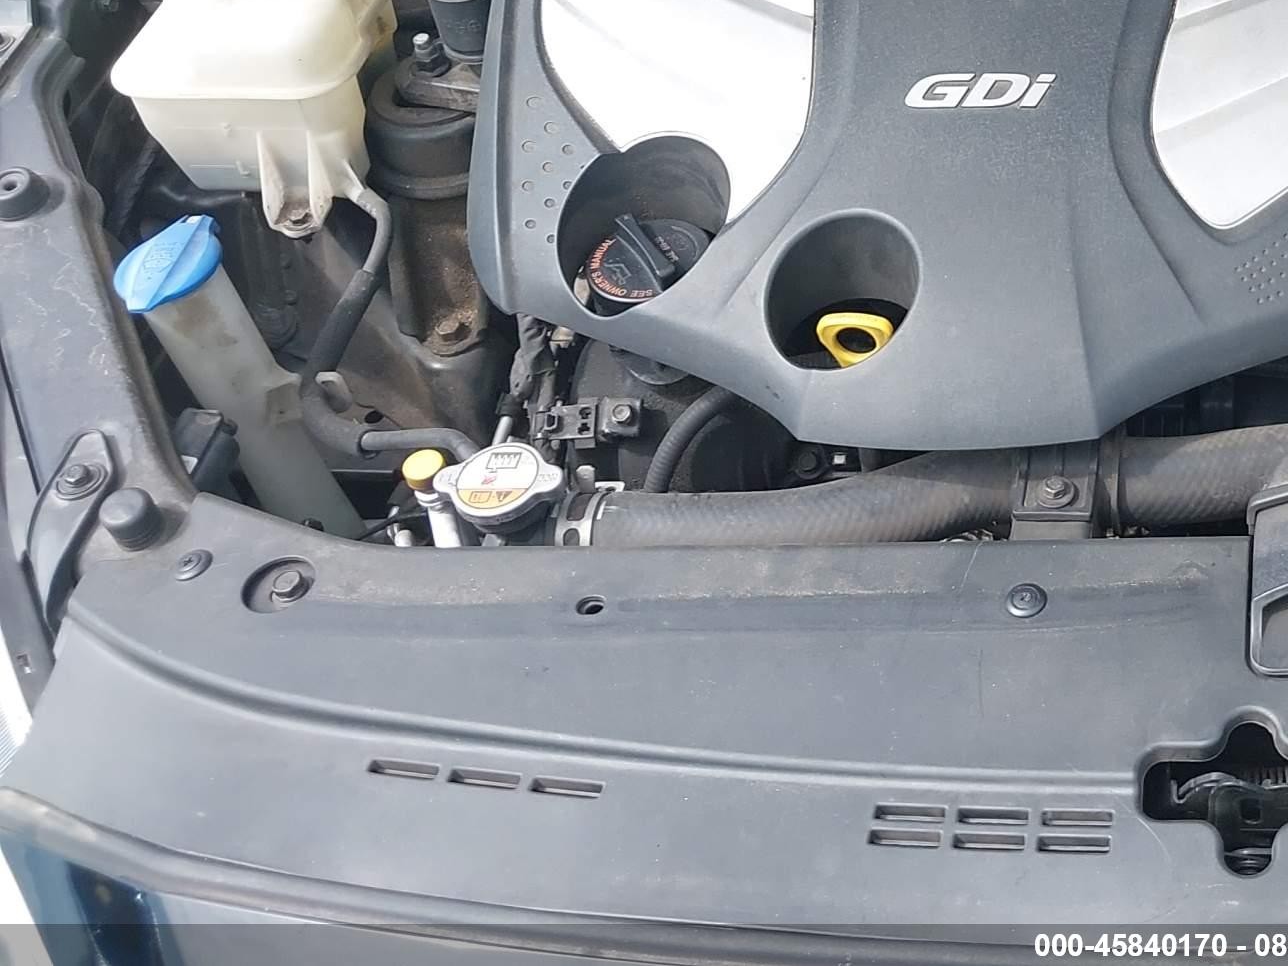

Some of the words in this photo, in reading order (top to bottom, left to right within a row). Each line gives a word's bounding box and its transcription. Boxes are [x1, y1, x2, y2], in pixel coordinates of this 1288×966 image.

[903, 73, 1056, 108] GDi
[590, 238, 617, 270] MANUAL
[592, 271, 627, 296] OWNER'S
[630, 289, 653, 298] SEE
